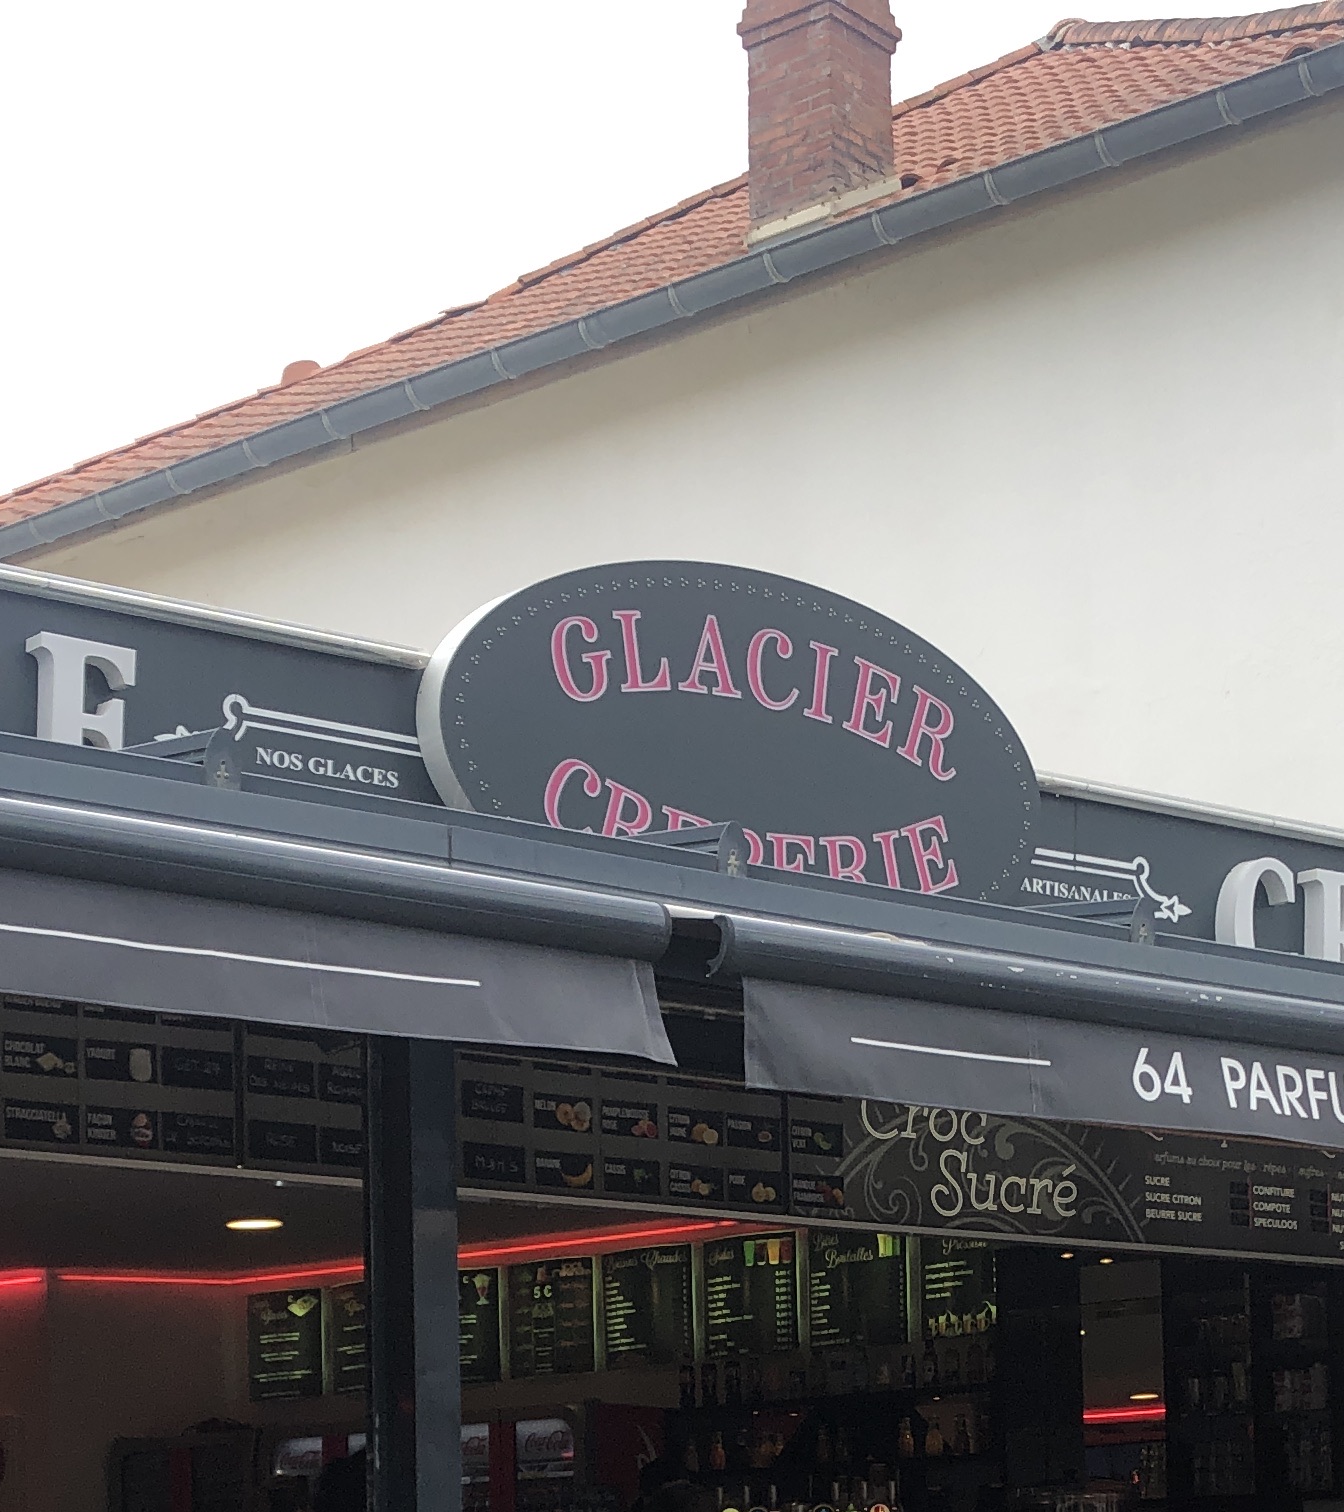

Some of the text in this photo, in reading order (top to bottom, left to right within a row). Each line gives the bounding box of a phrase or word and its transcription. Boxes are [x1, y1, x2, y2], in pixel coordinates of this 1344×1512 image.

[549, 608, 958, 782] GLACIER
[255, 746, 400, 790] NOS GLACES
[1133, 1048, 1193, 1104] 64
[930, 1149, 1078, 1217] Sucré
[1253, 1185, 1296, 1199] CONFITURE
[1172, 1193, 1202, 1207] CITRON
[1253, 1201, 1291, 1214] COMPOTE
[1145, 1208, 1176, 1222] BEURRE
[1254, 1217, 1298, 1231] SPECULOOS
